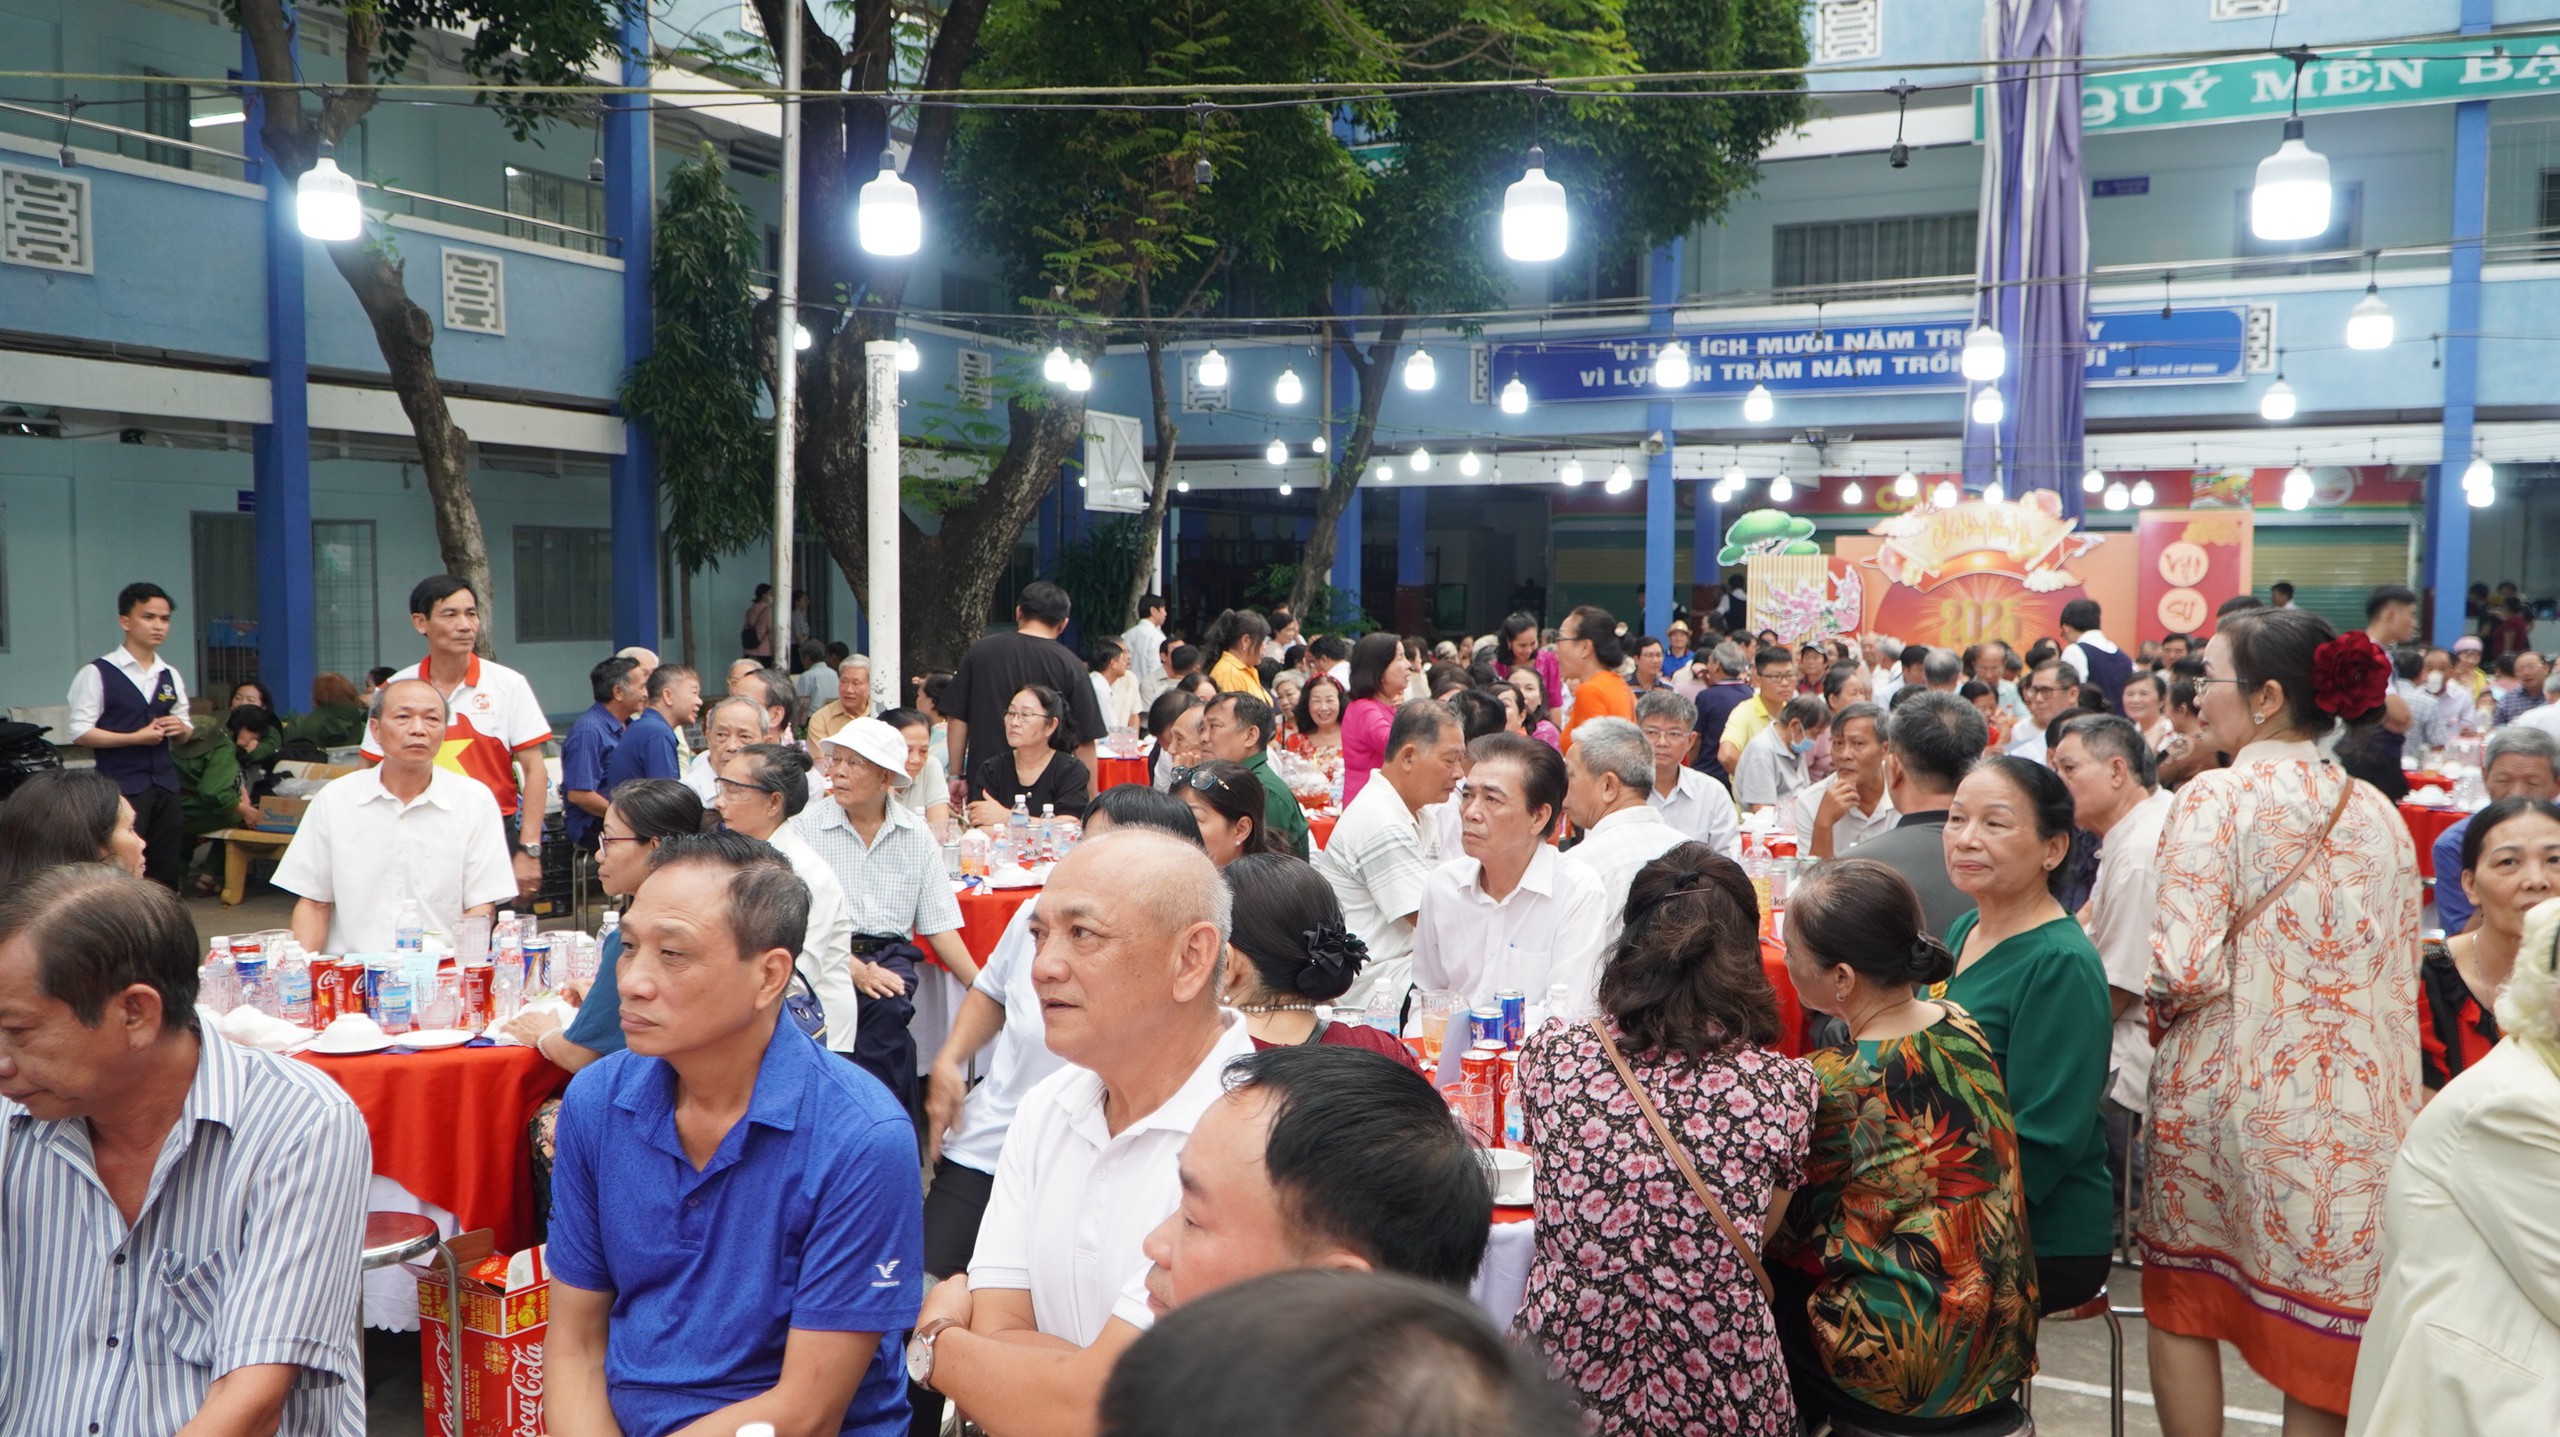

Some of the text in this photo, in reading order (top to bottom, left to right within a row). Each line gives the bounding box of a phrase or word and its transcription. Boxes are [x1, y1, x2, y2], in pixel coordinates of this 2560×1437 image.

[2251, 49, 2430, 104] MẾN
[1700, 335, 1748, 357] ÍCH
[1843, 328, 1915, 351] NĂM
[1580, 366, 1606, 388] VÌ
[1720, 358, 1802, 381] TRĂM
[1811, 354, 1882, 378] NĂM
[1940, 599, 2023, 646] 2025
[418, 1282, 433, 1317] 500
[506, 1314, 517, 1334] 500
